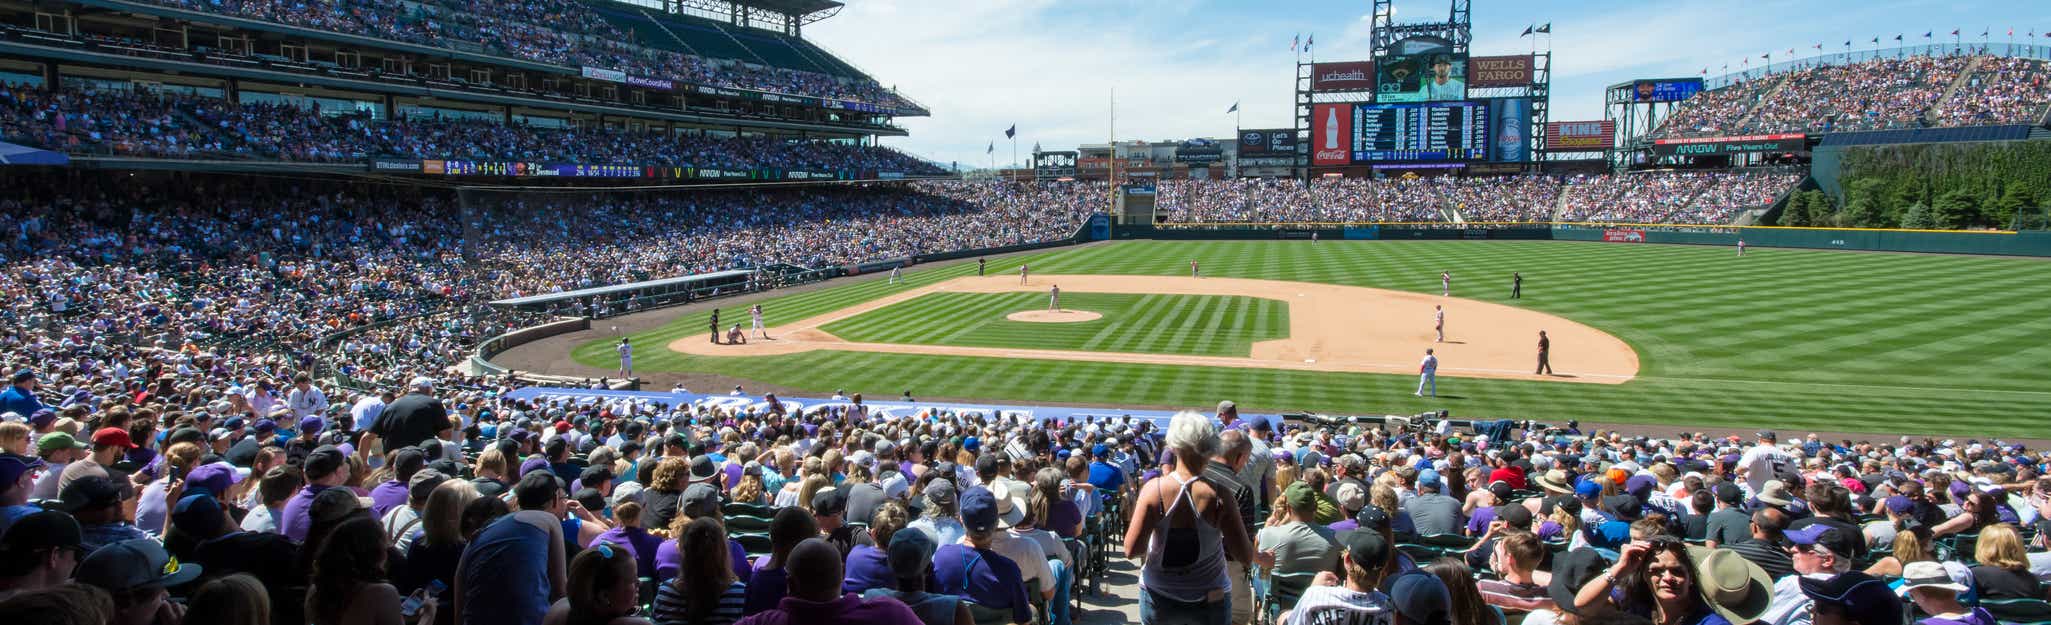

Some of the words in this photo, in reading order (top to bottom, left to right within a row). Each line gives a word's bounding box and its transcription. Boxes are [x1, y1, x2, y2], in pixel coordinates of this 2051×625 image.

[1477, 60, 1525, 70] WELLS
[1322, 68, 1365, 80] uchealth
[1477, 70, 1525, 80] FARGO
[627, 76, 672, 89] #LoveCoorsField
[1559, 123, 1602, 136] KING
